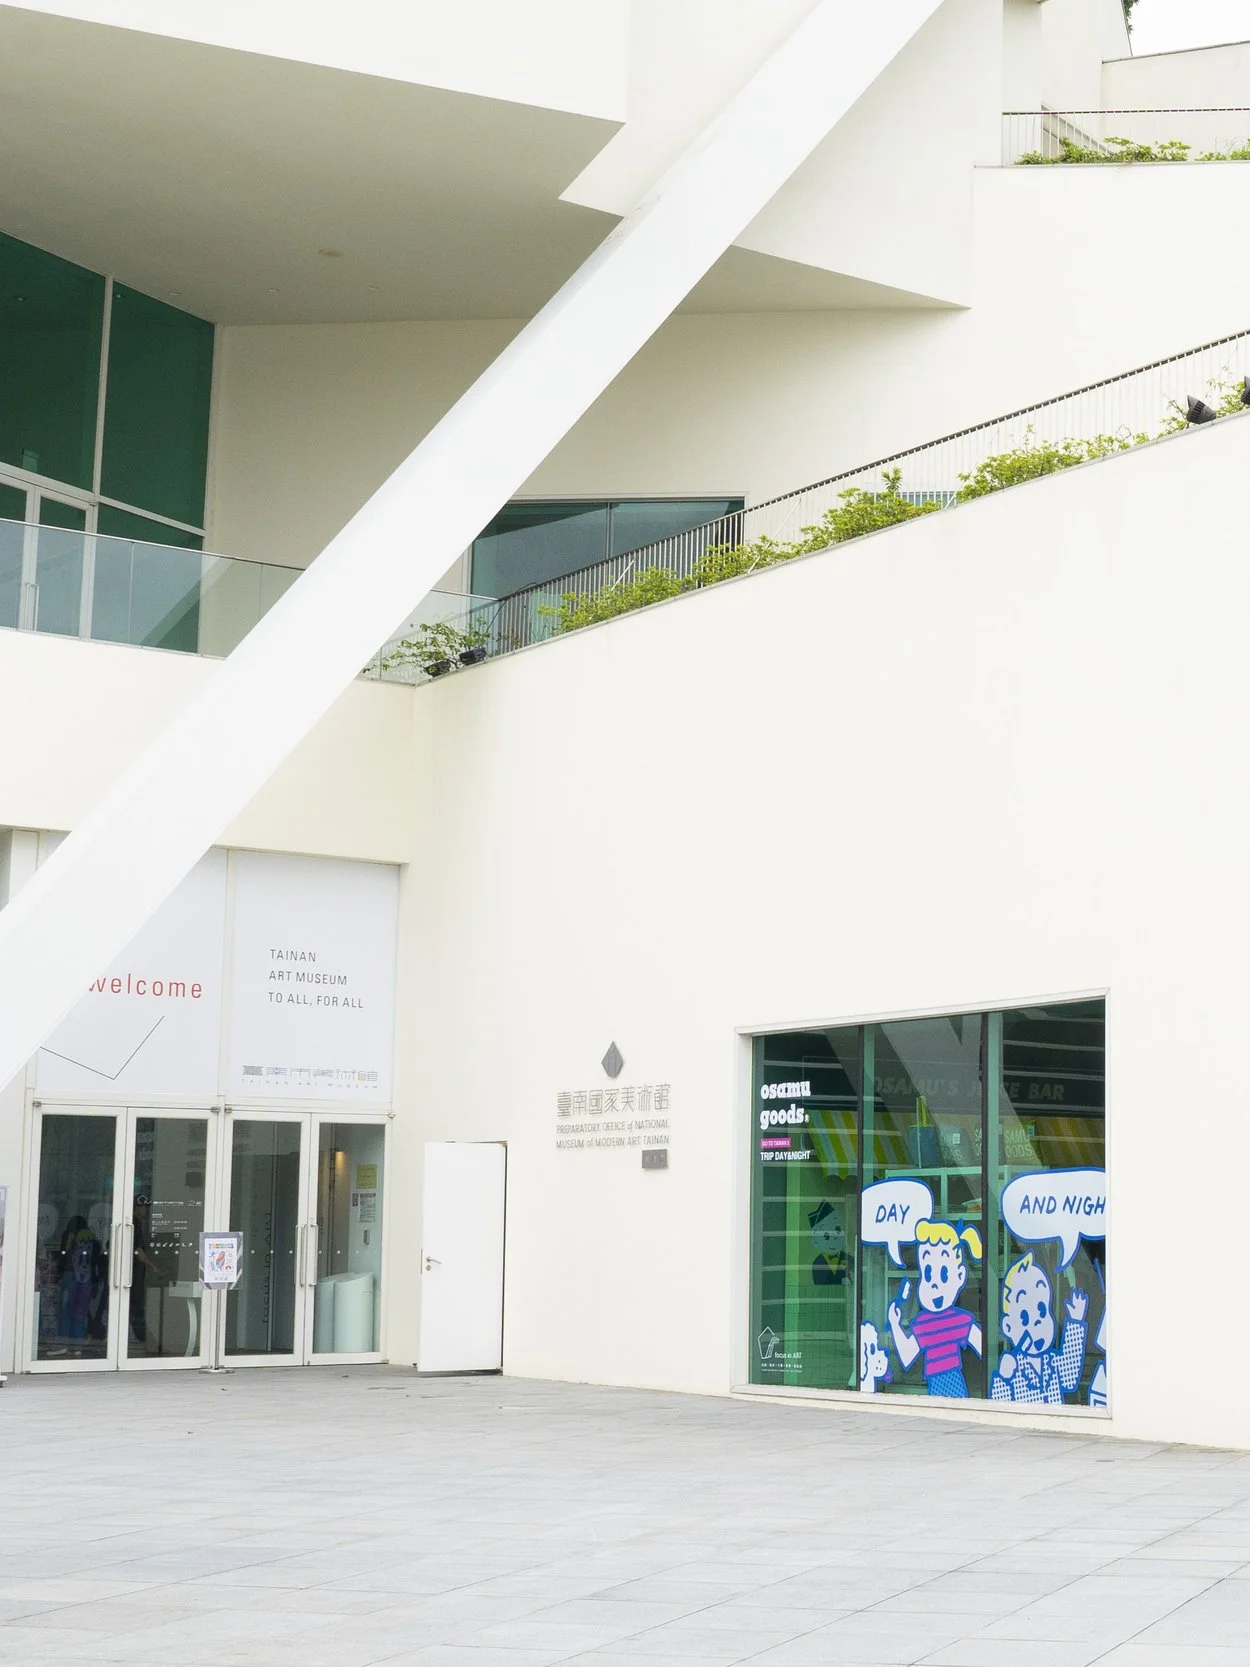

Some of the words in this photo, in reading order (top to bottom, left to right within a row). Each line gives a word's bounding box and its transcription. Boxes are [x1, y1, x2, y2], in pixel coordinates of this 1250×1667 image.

[270, 949, 317, 962] TAINAN
[88, 972, 202, 999] welcome
[269, 970, 292, 982] ART
[295, 971, 347, 986] MUSEUM
[268, 991, 283, 1003] TO
[287, 993, 313, 1006] ALL,
[316, 995, 338, 1006] FOR
[342, 997, 364, 1009] ALL
[760, 1081, 811, 1099] osamu
[1028, 1083, 1065, 1101] BAR
[556, 1123, 601, 1134] PREPARATORY
[602, 1121, 625, 1132] OFFICE
[635, 1119, 670, 1130] NATIONAL
[556, 1138, 585, 1149] MUSEUM
[595, 1136, 625, 1147] MODERN
[627, 1136, 641, 1146] ART
[643, 1134, 670, 1145] TAINAN
[760, 1151, 774, 1161] TRIP
[775, 1150, 811, 1160] DAY&NIGHT
[1019, 1194, 1057, 1215] AND
[875, 1204, 911, 1224] DAY
